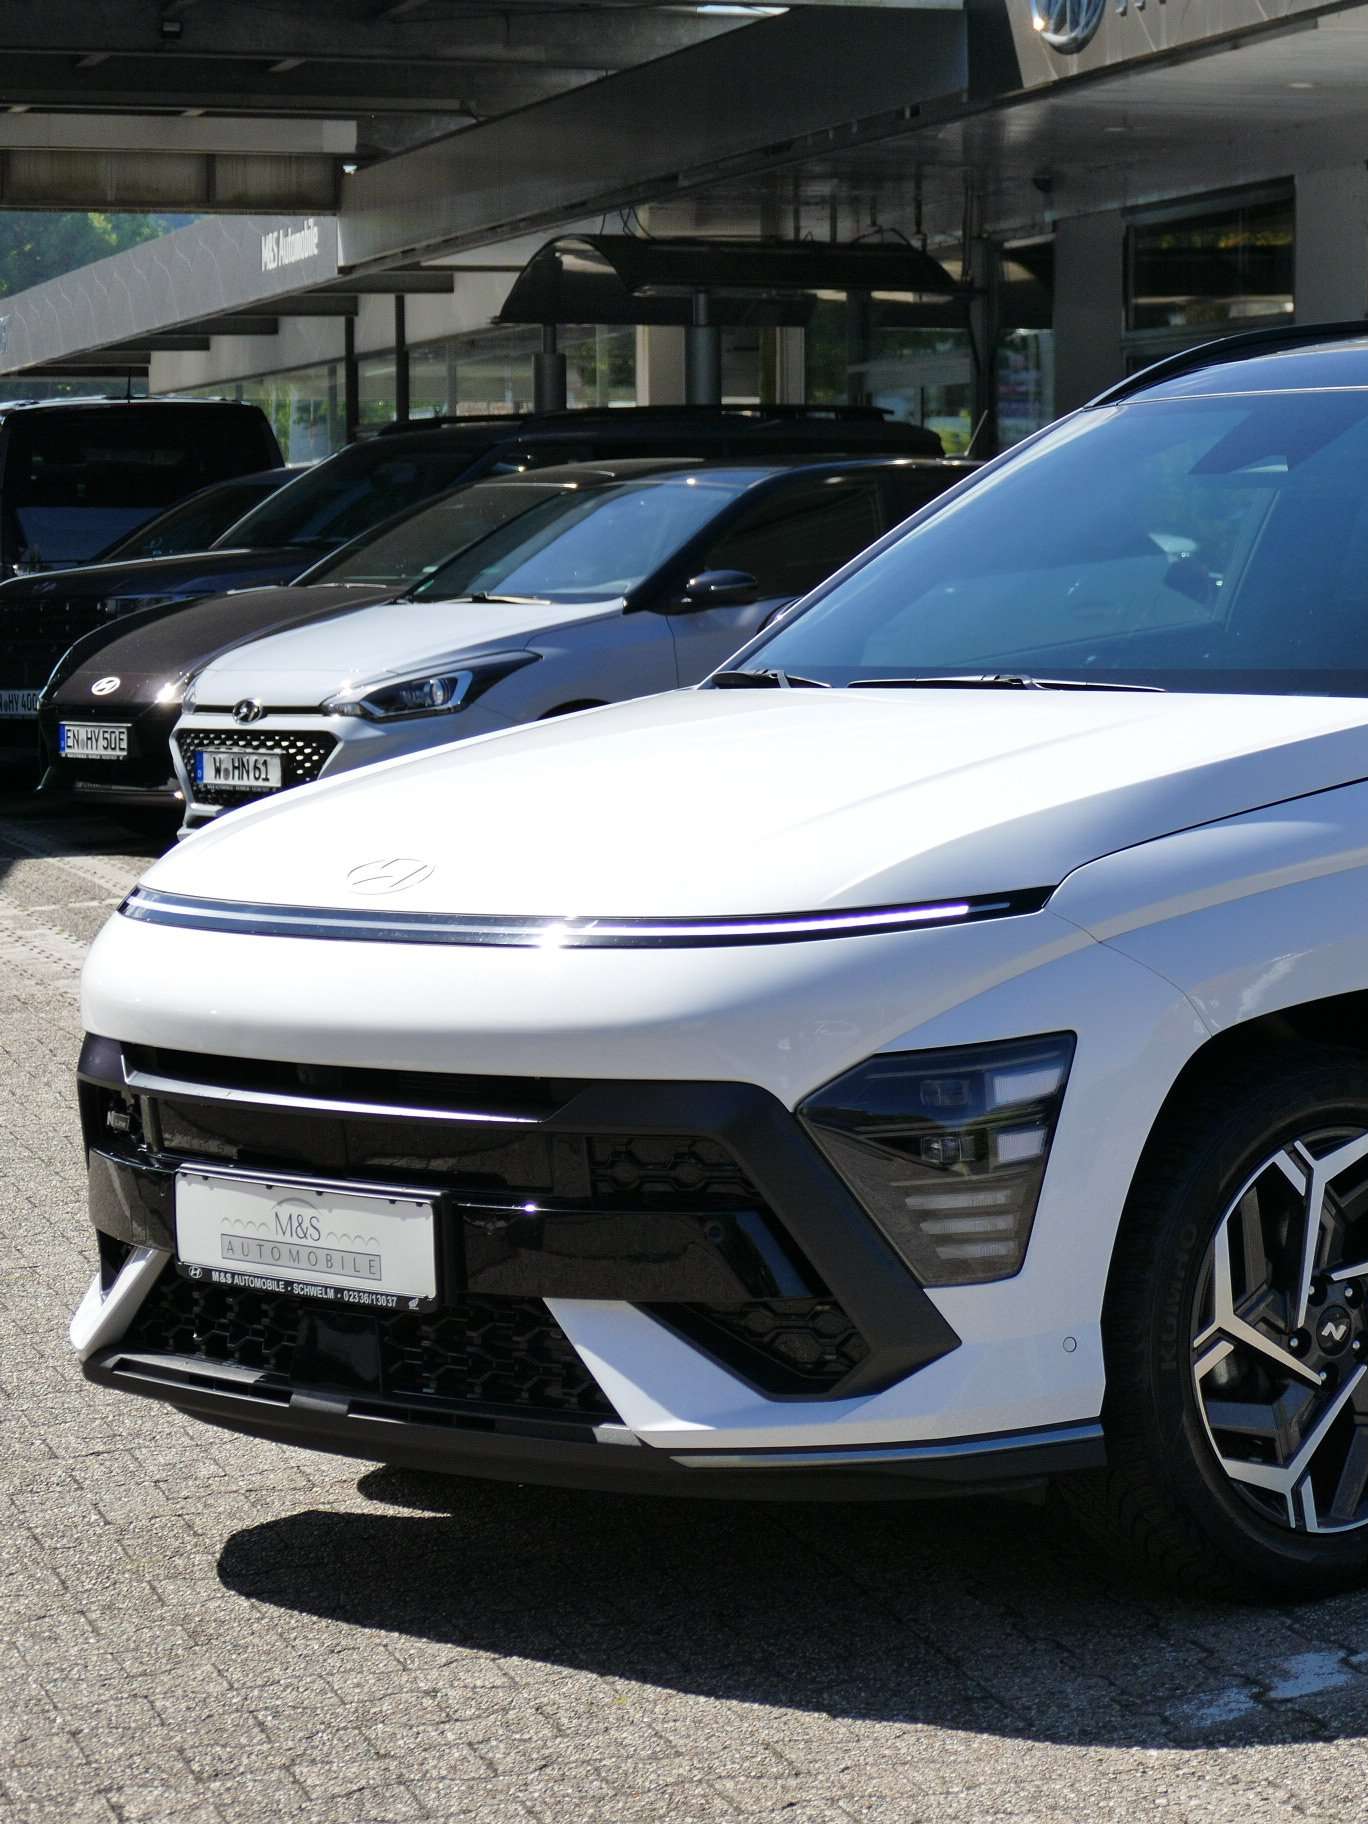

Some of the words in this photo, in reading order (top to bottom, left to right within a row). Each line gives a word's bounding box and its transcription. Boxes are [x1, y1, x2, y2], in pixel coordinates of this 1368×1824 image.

[279, 218, 318, 267] Automobile
[66, 728, 80, 750] EN
[213, 756, 222, 780] W
[231, 757, 250, 781] HN
[253, 758, 270, 782] 61
[274, 1211, 321, 1242] M&S
[226, 1240, 377, 1275] AUTOMOBILE
[211, 1270, 233, 1284] M&S
[233, 1273, 285, 1292] AUTOMOBILE
[293, 1283, 334, 1299] SCHWELM
[343, 1289, 397, 1308] 02336/13037
